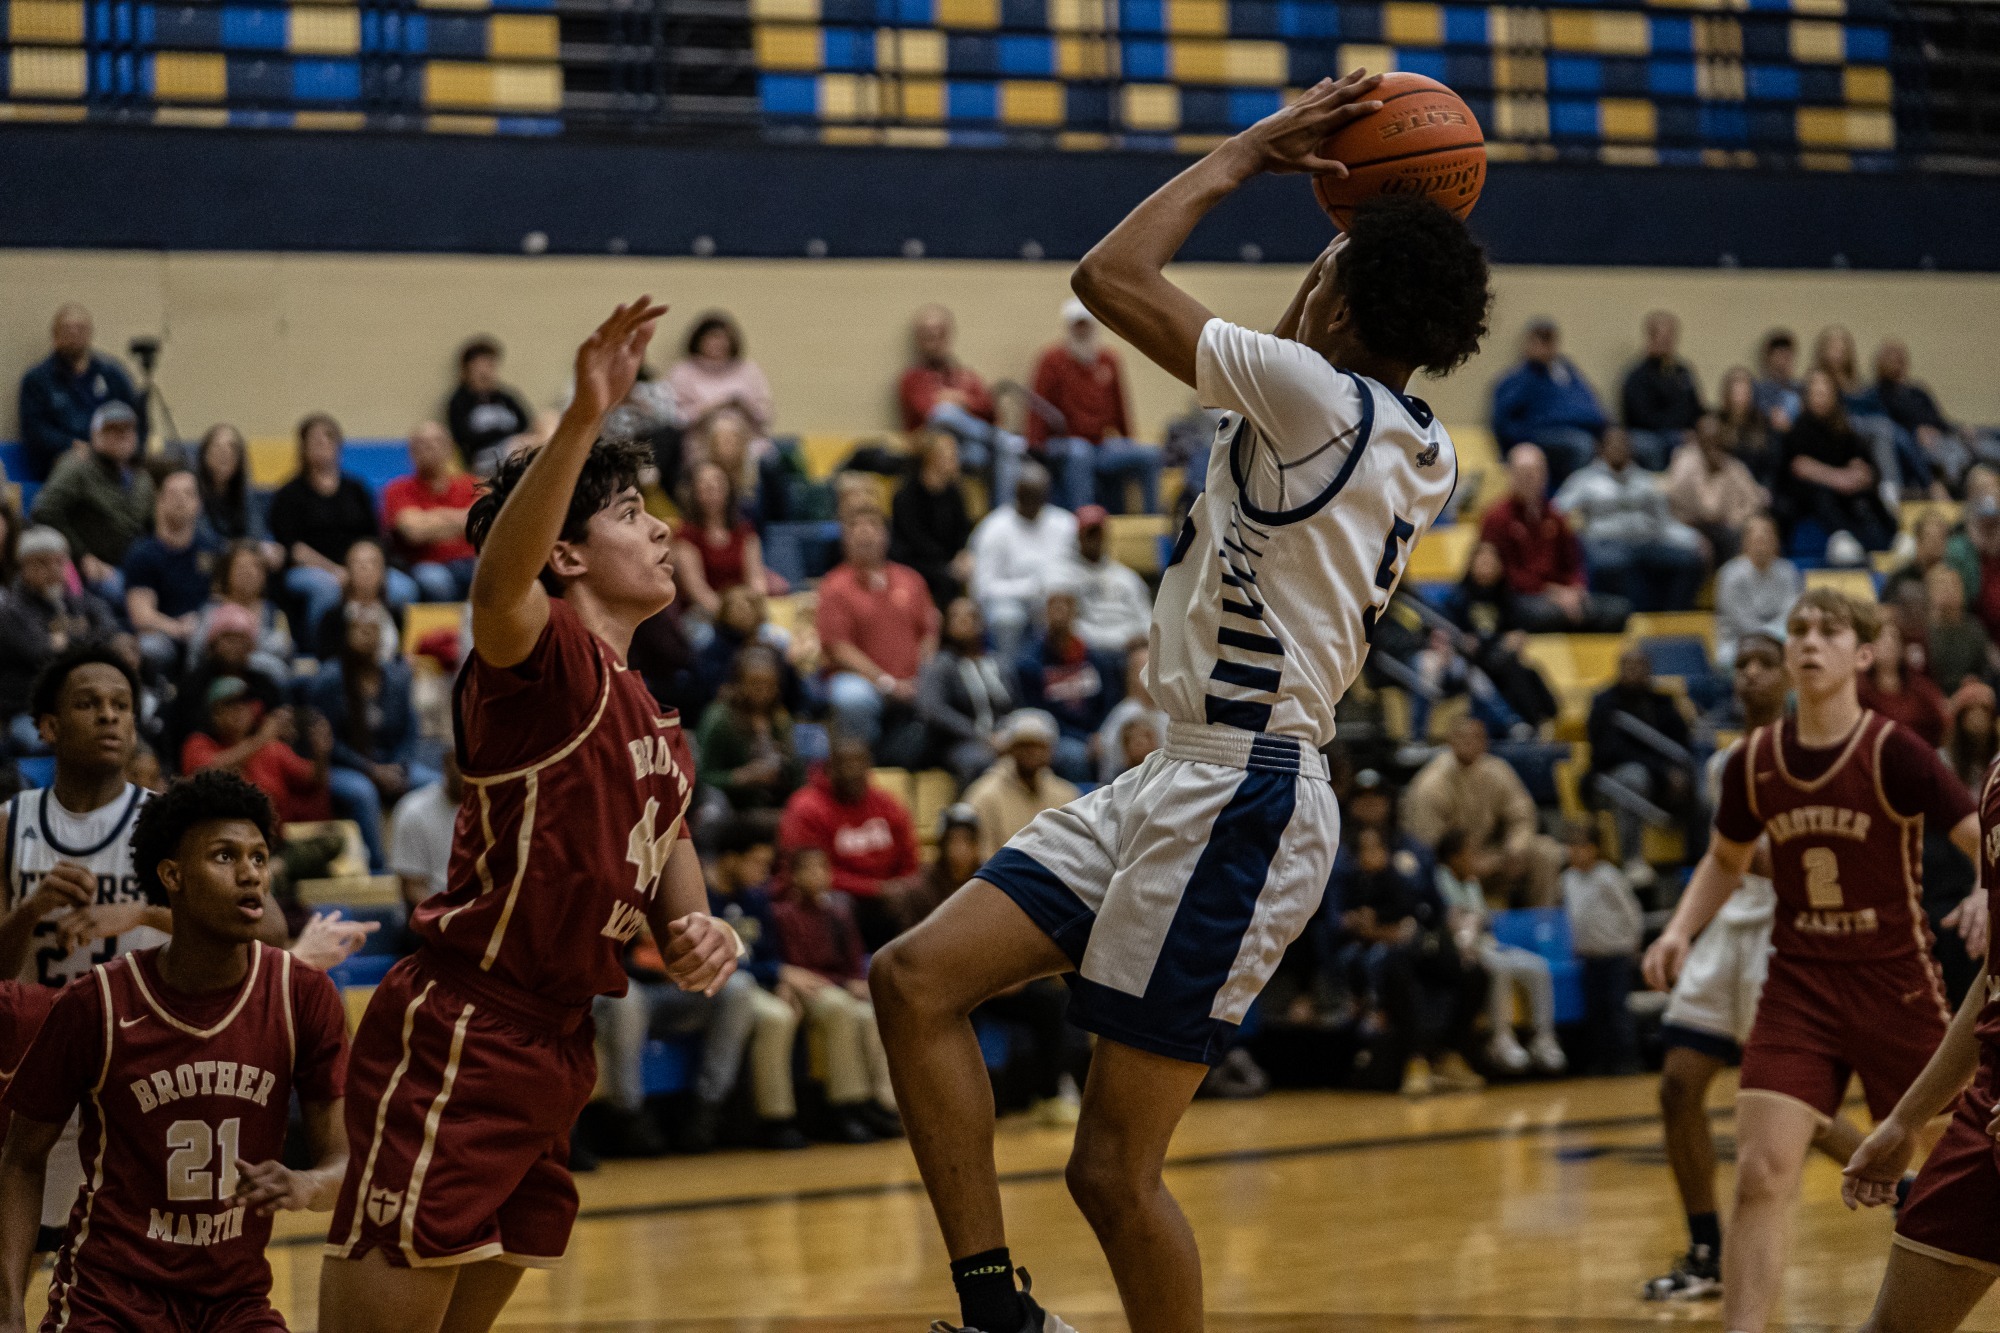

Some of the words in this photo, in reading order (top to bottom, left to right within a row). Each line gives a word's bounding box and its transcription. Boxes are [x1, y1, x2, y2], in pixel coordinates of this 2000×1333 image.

[1378, 111, 1468, 140] ELITE
[1380, 163, 1480, 197] Baden
[1802, 846, 1844, 909] 2
[129, 1060, 276, 1114] BROTHER
[166, 1117, 241, 1201] 21
[146, 1207, 246, 1246] MARTIN
